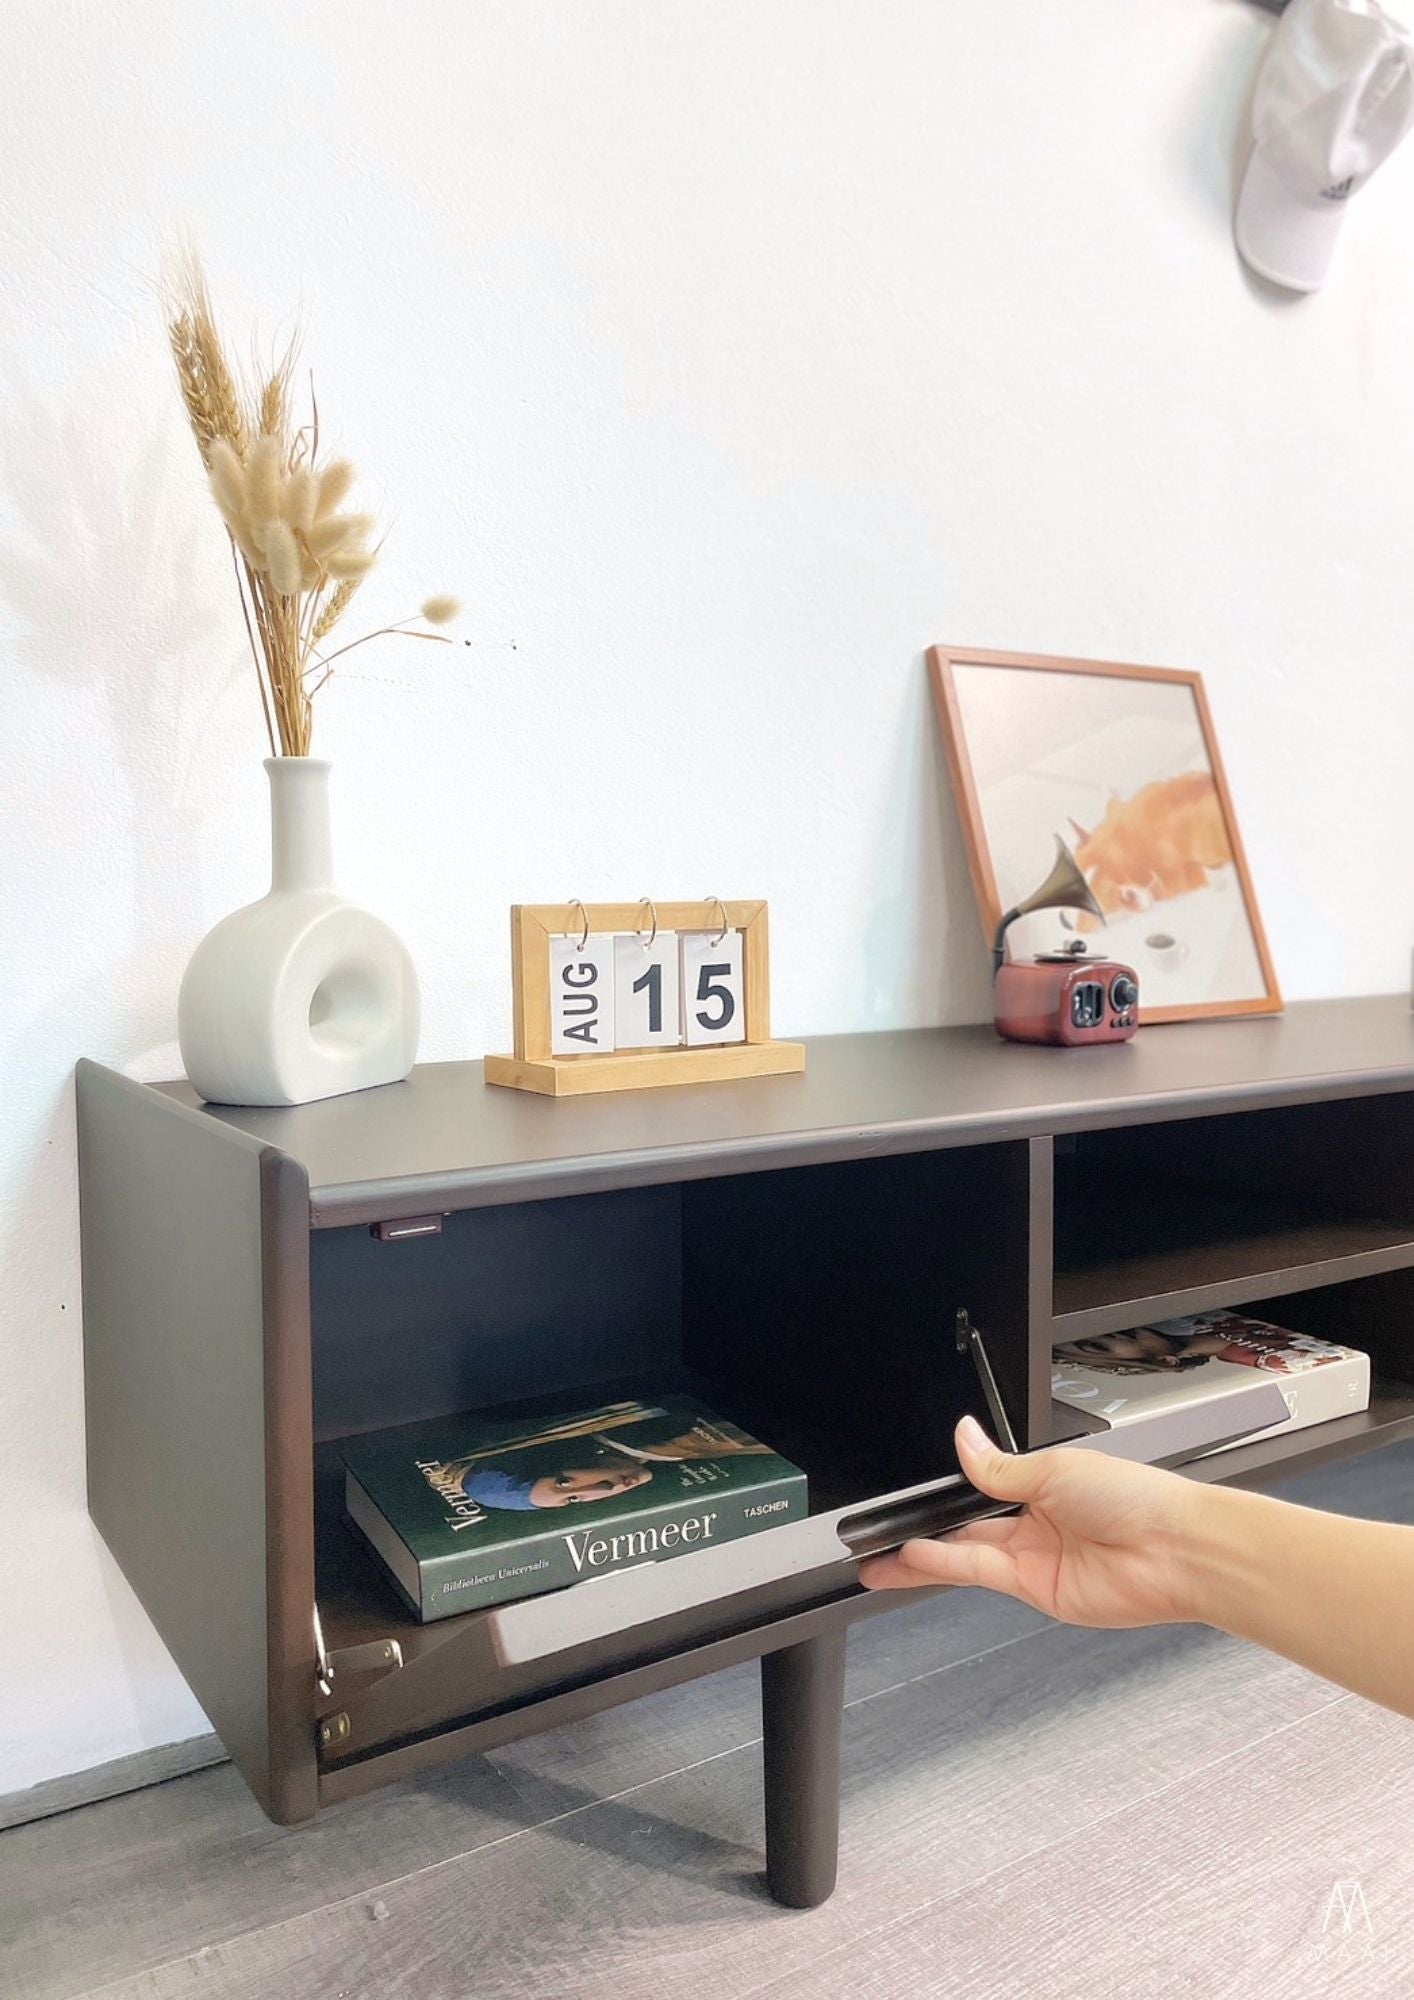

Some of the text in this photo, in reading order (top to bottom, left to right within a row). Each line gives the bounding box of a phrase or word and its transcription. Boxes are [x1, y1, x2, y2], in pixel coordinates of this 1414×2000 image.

[562, 962, 598, 1044] AUG
[415, 1461, 488, 1532] Vermeer
[562, 1512, 717, 1573] Vermeer
[743, 1500, 789, 1518] TASCHEN
